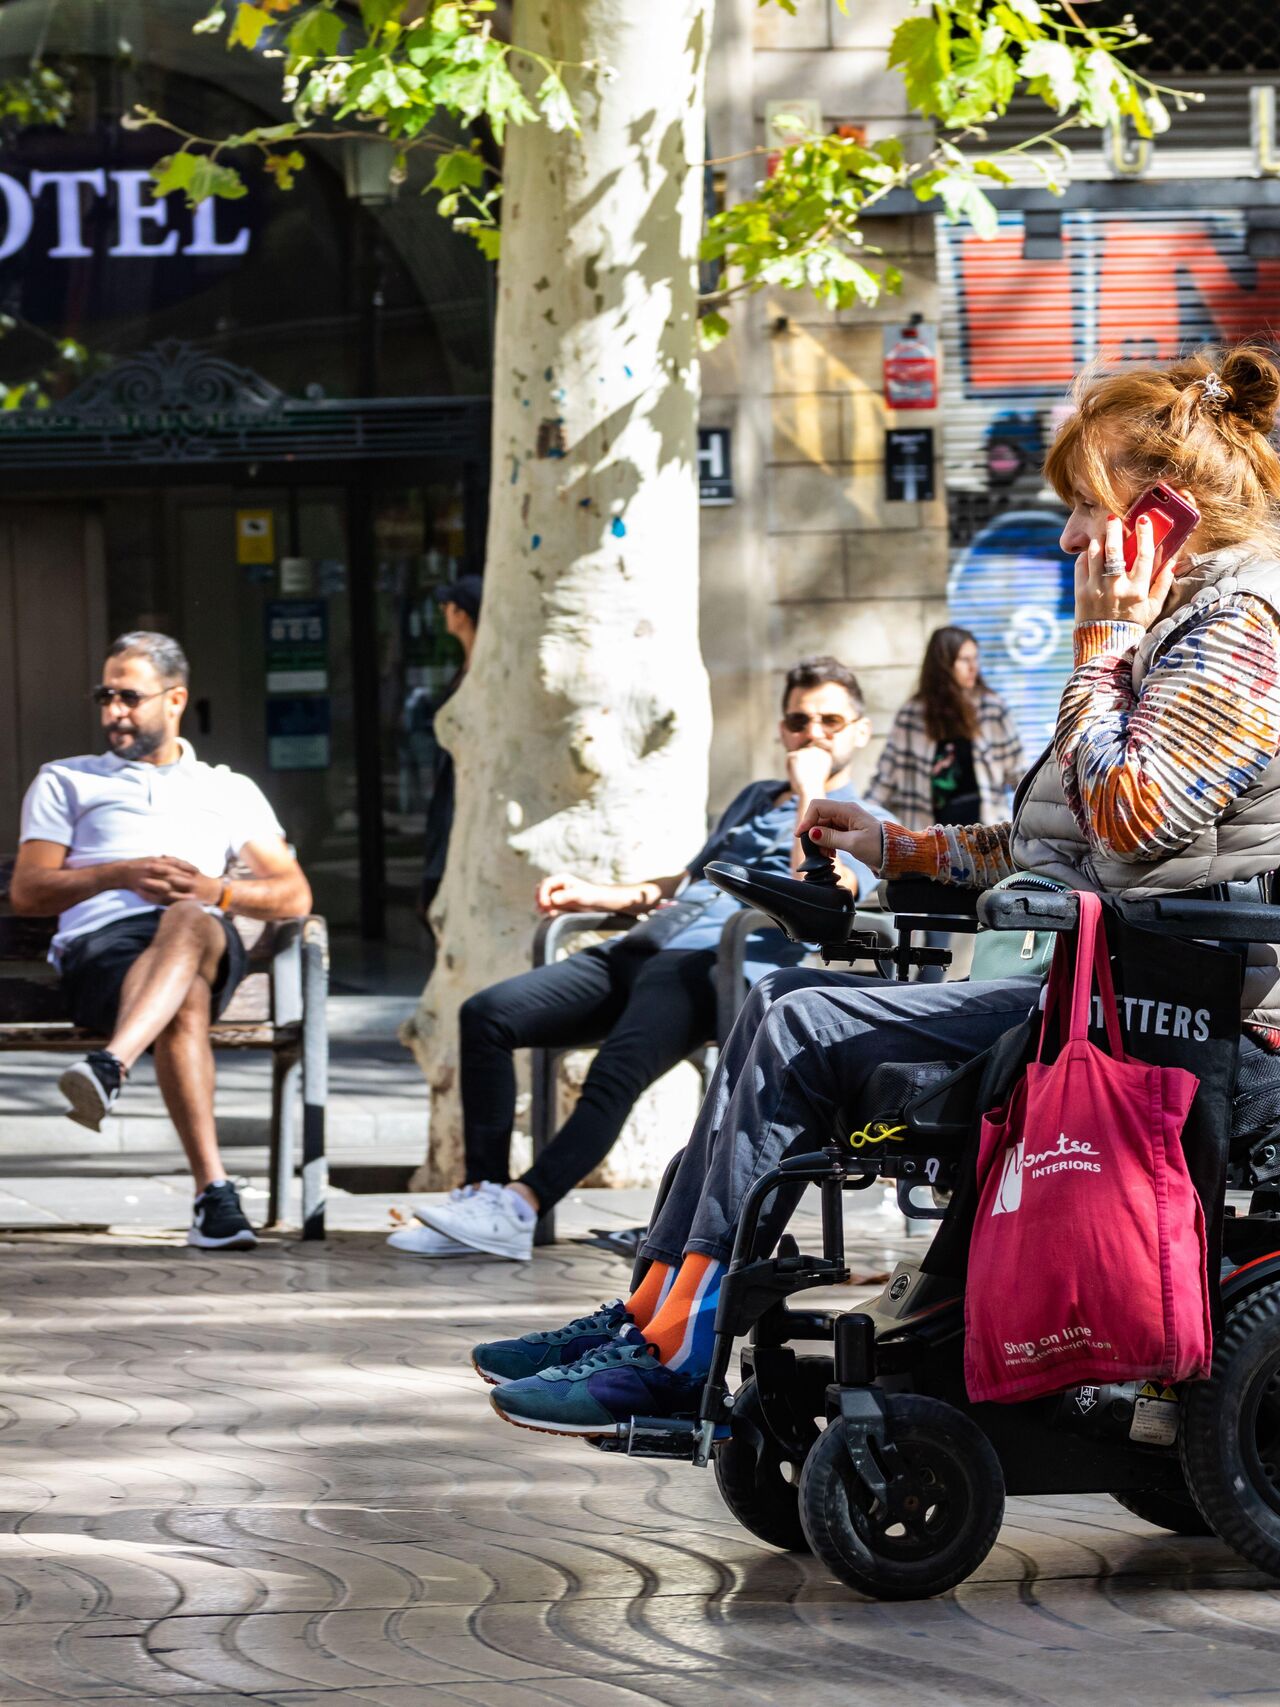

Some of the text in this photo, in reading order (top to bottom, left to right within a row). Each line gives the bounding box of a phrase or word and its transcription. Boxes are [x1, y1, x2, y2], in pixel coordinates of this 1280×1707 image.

[1032, 1160, 1102, 1179] INTERIORS
[1040, 1333, 1060, 1346] on
[1062, 1326, 1092, 1340] line
